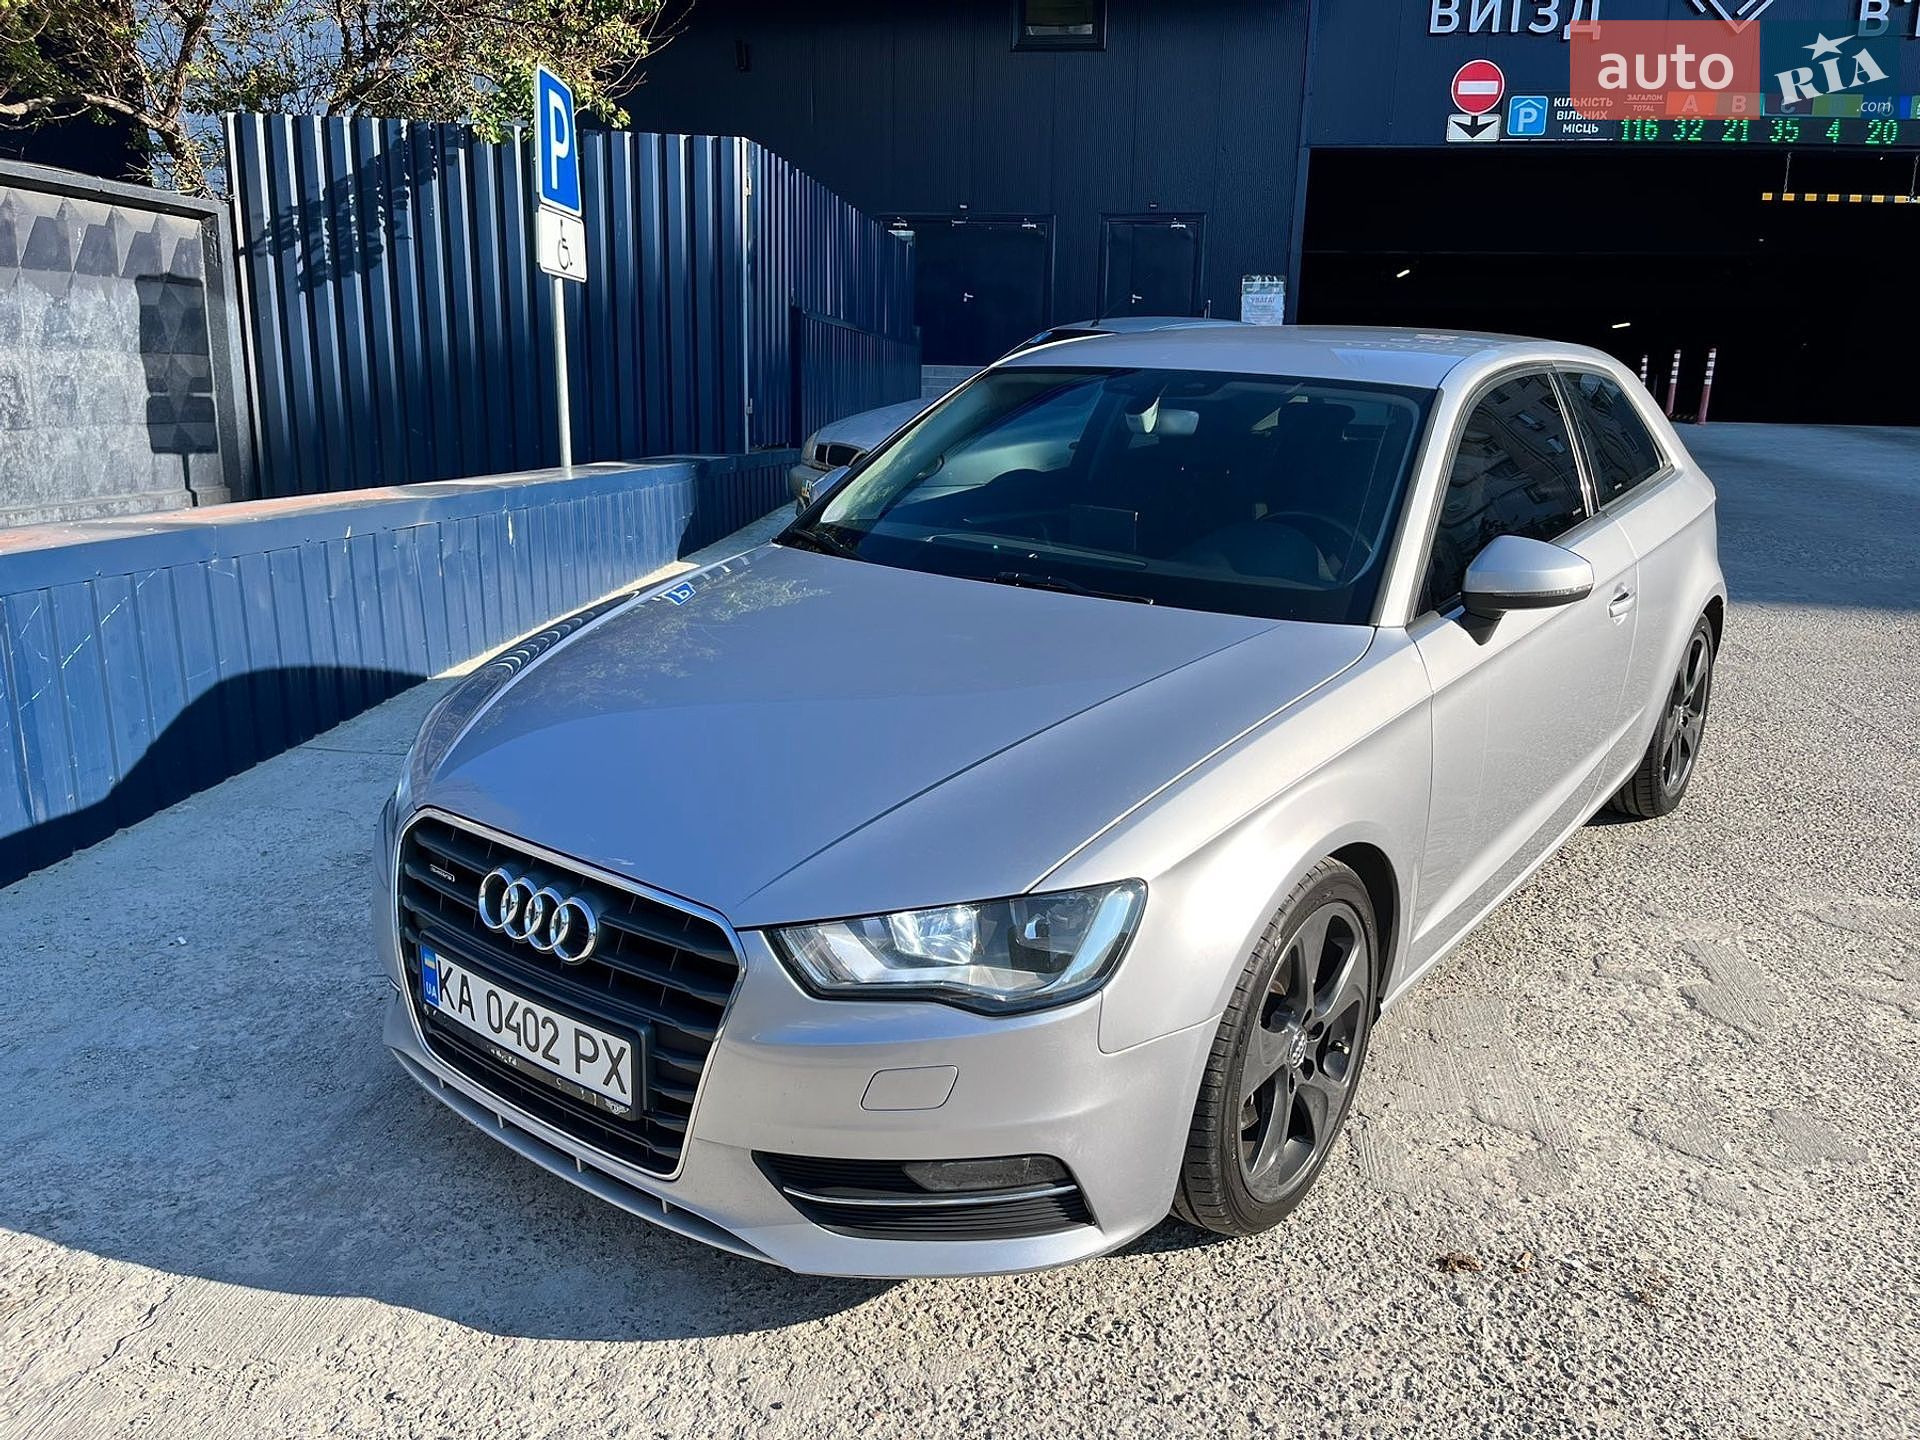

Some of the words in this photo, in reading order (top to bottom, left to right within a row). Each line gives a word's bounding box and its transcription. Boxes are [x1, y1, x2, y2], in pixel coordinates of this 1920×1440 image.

[1553, 97, 1614, 107] КІЛЬКІСТЬ
[1632, 104, 1655, 112] TOTAL
[1681, 95, 1698, 112] A
[1731, 95, 1746, 112] B
[1517, 107, 1538, 132] P
[1556, 110, 1608, 120] ВІЛЬНИХ
[1562, 123, 1599, 135] МІСЦЬ
[1620, 116, 1658, 141] 116
[1672, 116, 1704, 141] 32
[1721, 116, 1749, 141] 21
[1769, 118, 1800, 142] 35
[1825, 118, 1840, 143] 4
[1864, 119, 1898, 144] 20
[549, 88, 569, 190] P
[425, 981, 438, 999] UA
[437, 959, 476, 1022] KA
[486, 989, 560, 1065] 0402
[574, 1027, 627, 1095] PX
